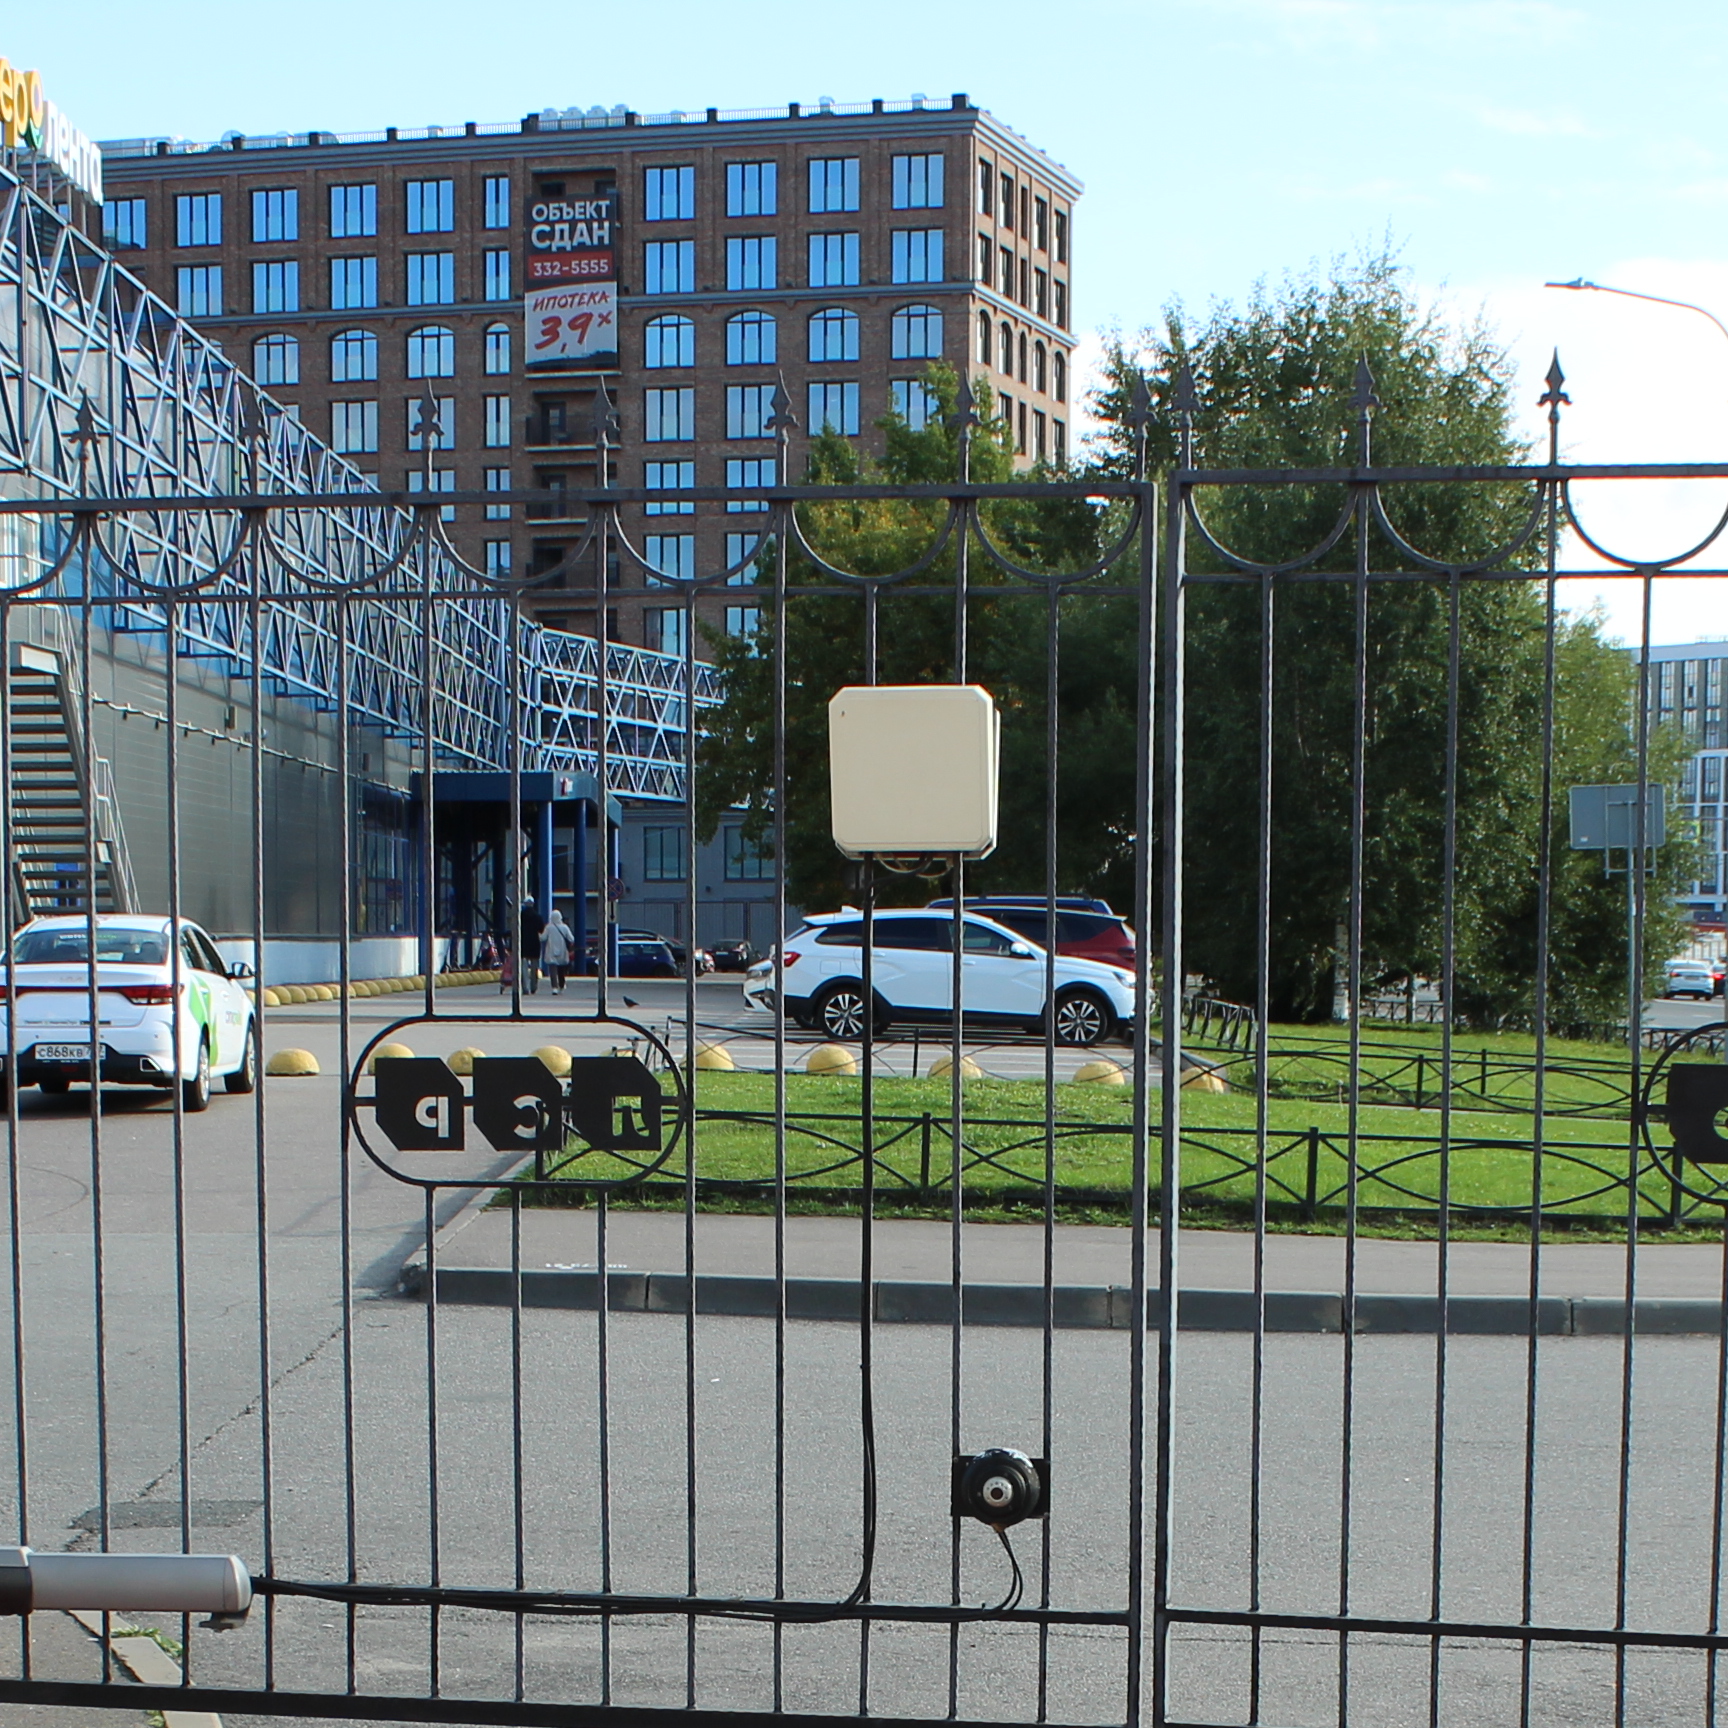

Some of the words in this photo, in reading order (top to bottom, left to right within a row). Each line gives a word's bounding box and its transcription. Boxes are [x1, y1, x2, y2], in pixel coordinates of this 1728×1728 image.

[532, 200, 610, 222] ОБЪЕКТ
[531, 221, 611, 252] СДАН
[533, 259, 610, 277] 332-5555
[533, 291, 610, 312] ИПОТЕКА
